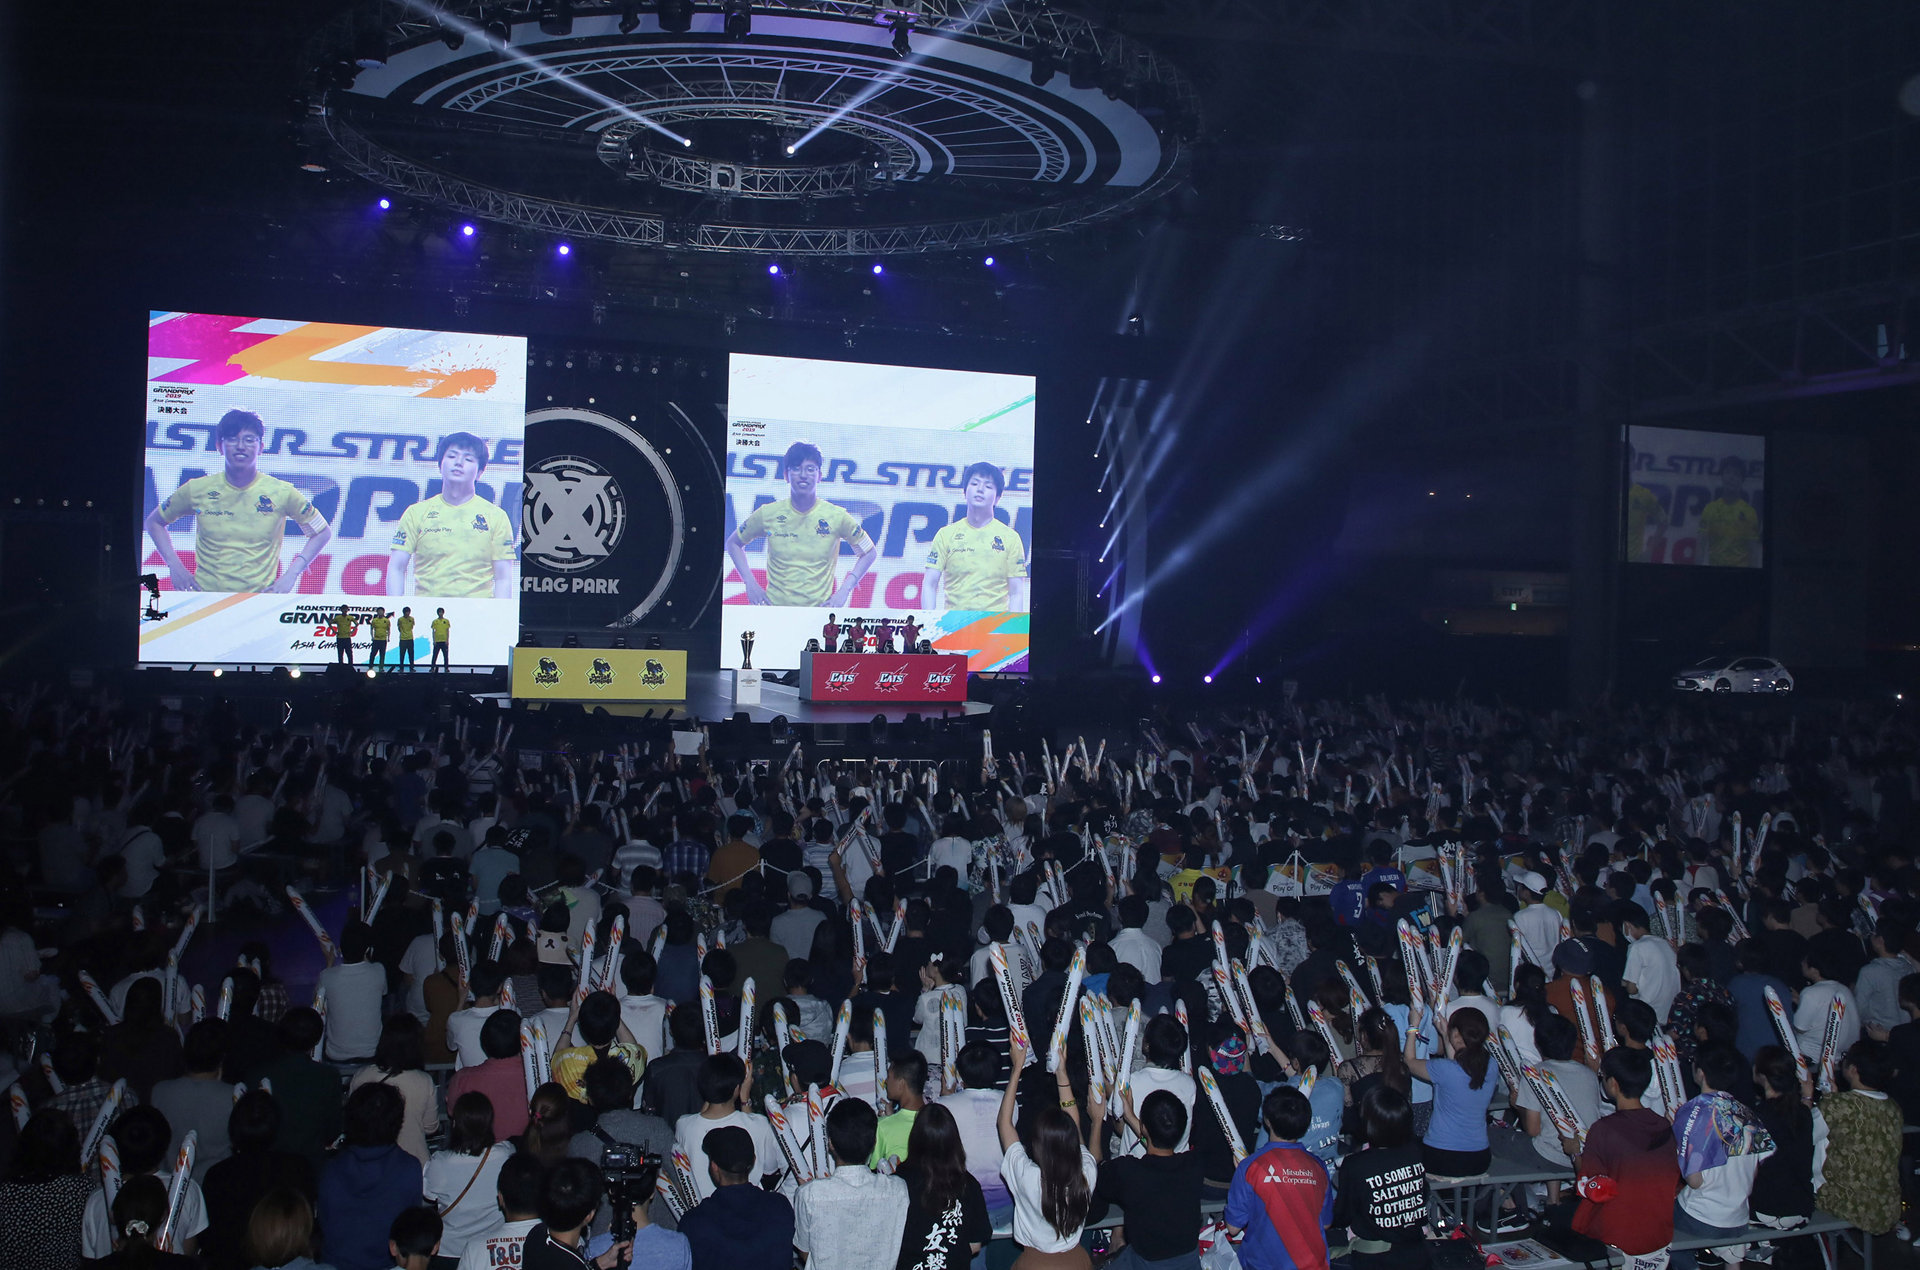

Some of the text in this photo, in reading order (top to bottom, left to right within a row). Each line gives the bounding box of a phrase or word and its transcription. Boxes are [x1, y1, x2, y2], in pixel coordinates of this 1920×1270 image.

[572, 578, 620, 594] PARK
[830, 672, 855, 682] CATS
[880, 673, 904, 683] CATS
[928, 674, 952, 683] CATS
[1272, 884, 1286, 892] Play
[1003, 969, 1025, 1031] GRANDPRIX 2019
[1827, 1012, 1836, 1048] GRANDPRIX
[1529, 1078, 1550, 1110] GRANDPRIX
[1549, 1086, 1580, 1134] GRANDPRIX 2019
[1685, 1118, 1696, 1136] PARK
[1691, 1106, 1701, 1119] 2019
[1282, 1168, 1314, 1177] Mitsubishi
[1282, 1176, 1317, 1186] Corporation
[1366, 1175, 1383, 1189] TO
[1384, 1166, 1414, 1184] SOME
[1369, 1194, 1424, 1216] TO OTHERS
[487, 1243, 521, 1266] T&C
[1634, 1258, 1659, 1268] Happy
